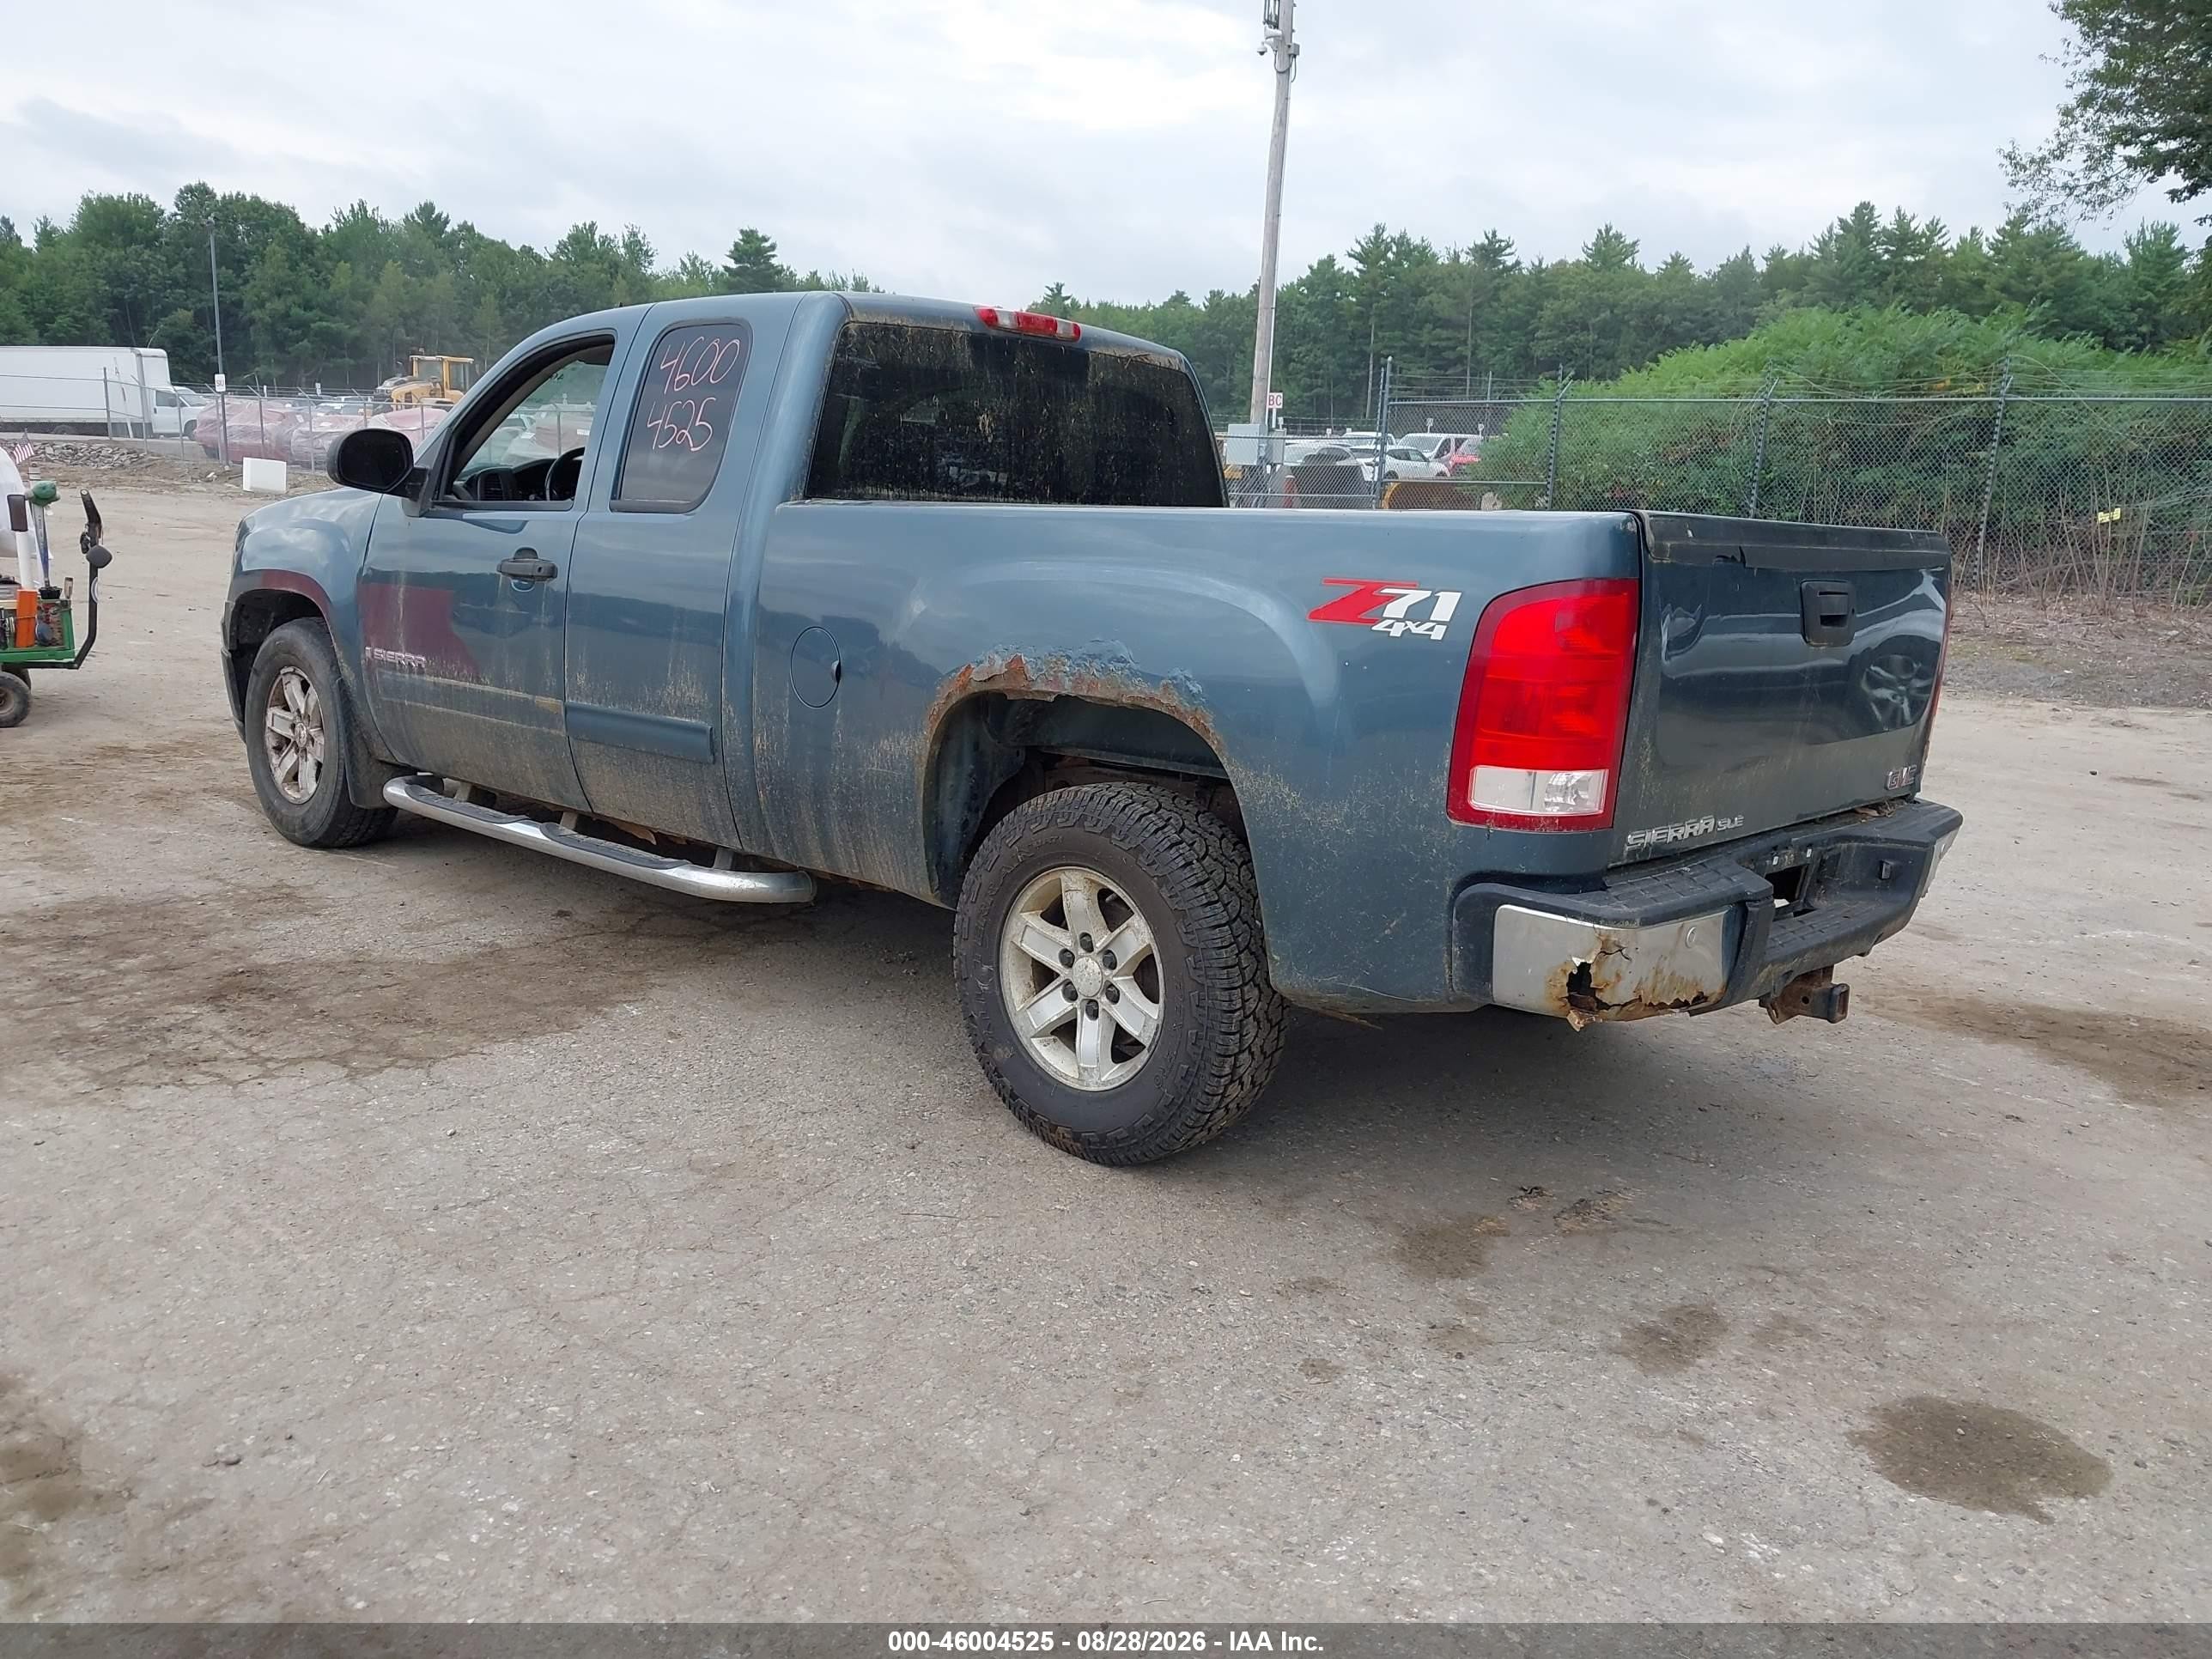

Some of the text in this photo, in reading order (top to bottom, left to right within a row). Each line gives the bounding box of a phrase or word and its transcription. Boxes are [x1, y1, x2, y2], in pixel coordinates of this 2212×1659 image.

[659, 336, 740, 395] 4600
[1268, 394, 1282, 406] BC
[647, 397, 716, 452] 4525
[1306, 577, 1462, 625] Z71
[373, 647, 426, 668] SIERRA
[1887, 764, 1917, 790] GMC
[1626, 814, 1745, 848] SIERRA SLE
